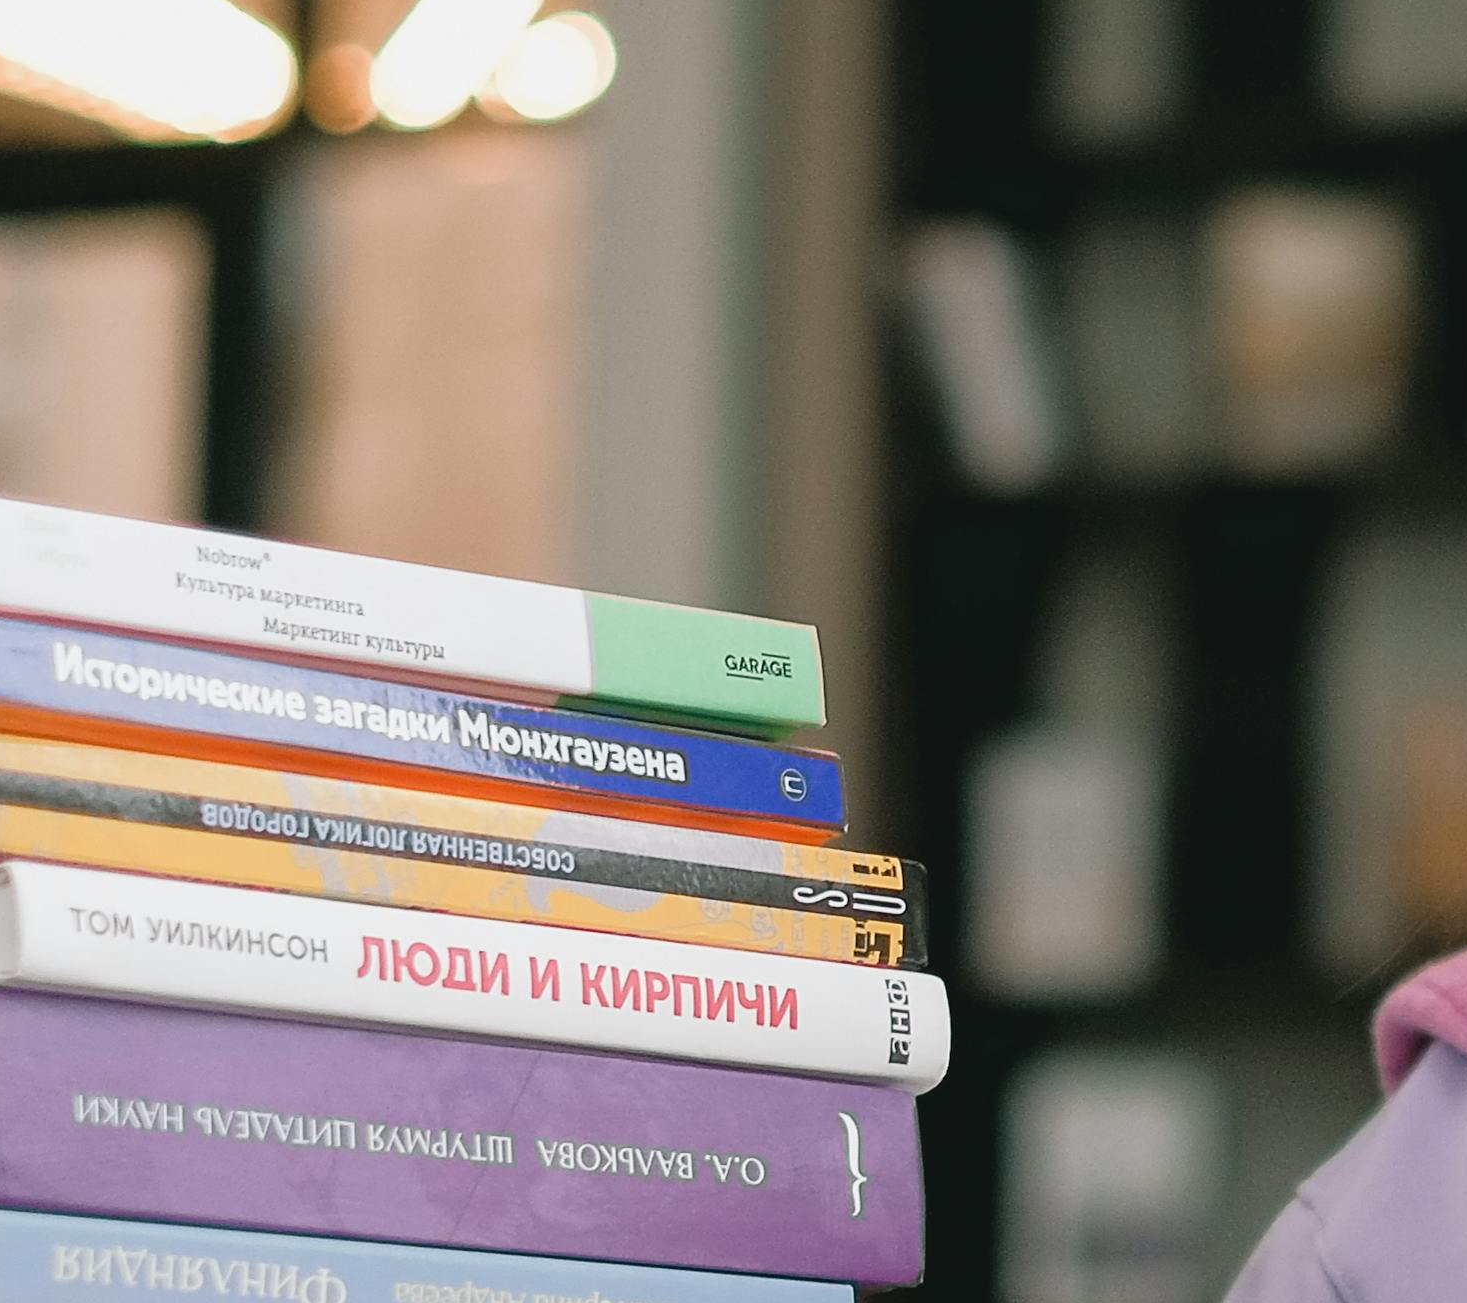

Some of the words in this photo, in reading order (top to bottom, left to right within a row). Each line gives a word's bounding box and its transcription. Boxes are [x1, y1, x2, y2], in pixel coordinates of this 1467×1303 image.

[174, 570, 256, 602] Культура
[259, 585, 365, 617] маркетинга
[261, 614, 362, 649] Маркетинг
[364, 632, 446, 662] культуры
[724, 653, 793, 680] GARAGE
[51, 641, 307, 722] Исторические
[313, 690, 453, 745] загадки
[456, 708, 689, 785] Мюнхгаузена
[200, 799, 311, 840] ГОРОДОВ
[314, 817, 409, 854] ЛОГИКА
[410, 832, 578, 876] СОБСТВЕННАЯ
[69, 906, 135, 940] ТОМ
[145, 914, 329, 965] УИЛКИНСОН
[356, 934, 511, 999] ЛЮДИ
[530, 955, 562, 1002] И
[580, 959, 801, 1032] КИРПИЧИ
[72, 1092, 184, 1134] НАУКИ
[192, 1106, 358, 1151] ЦИТАДЕЛЬ
[365, 1121, 514, 1166] ШТУРМУЯ
[537, 1139, 695, 1181] ВАЛЬКОВА
